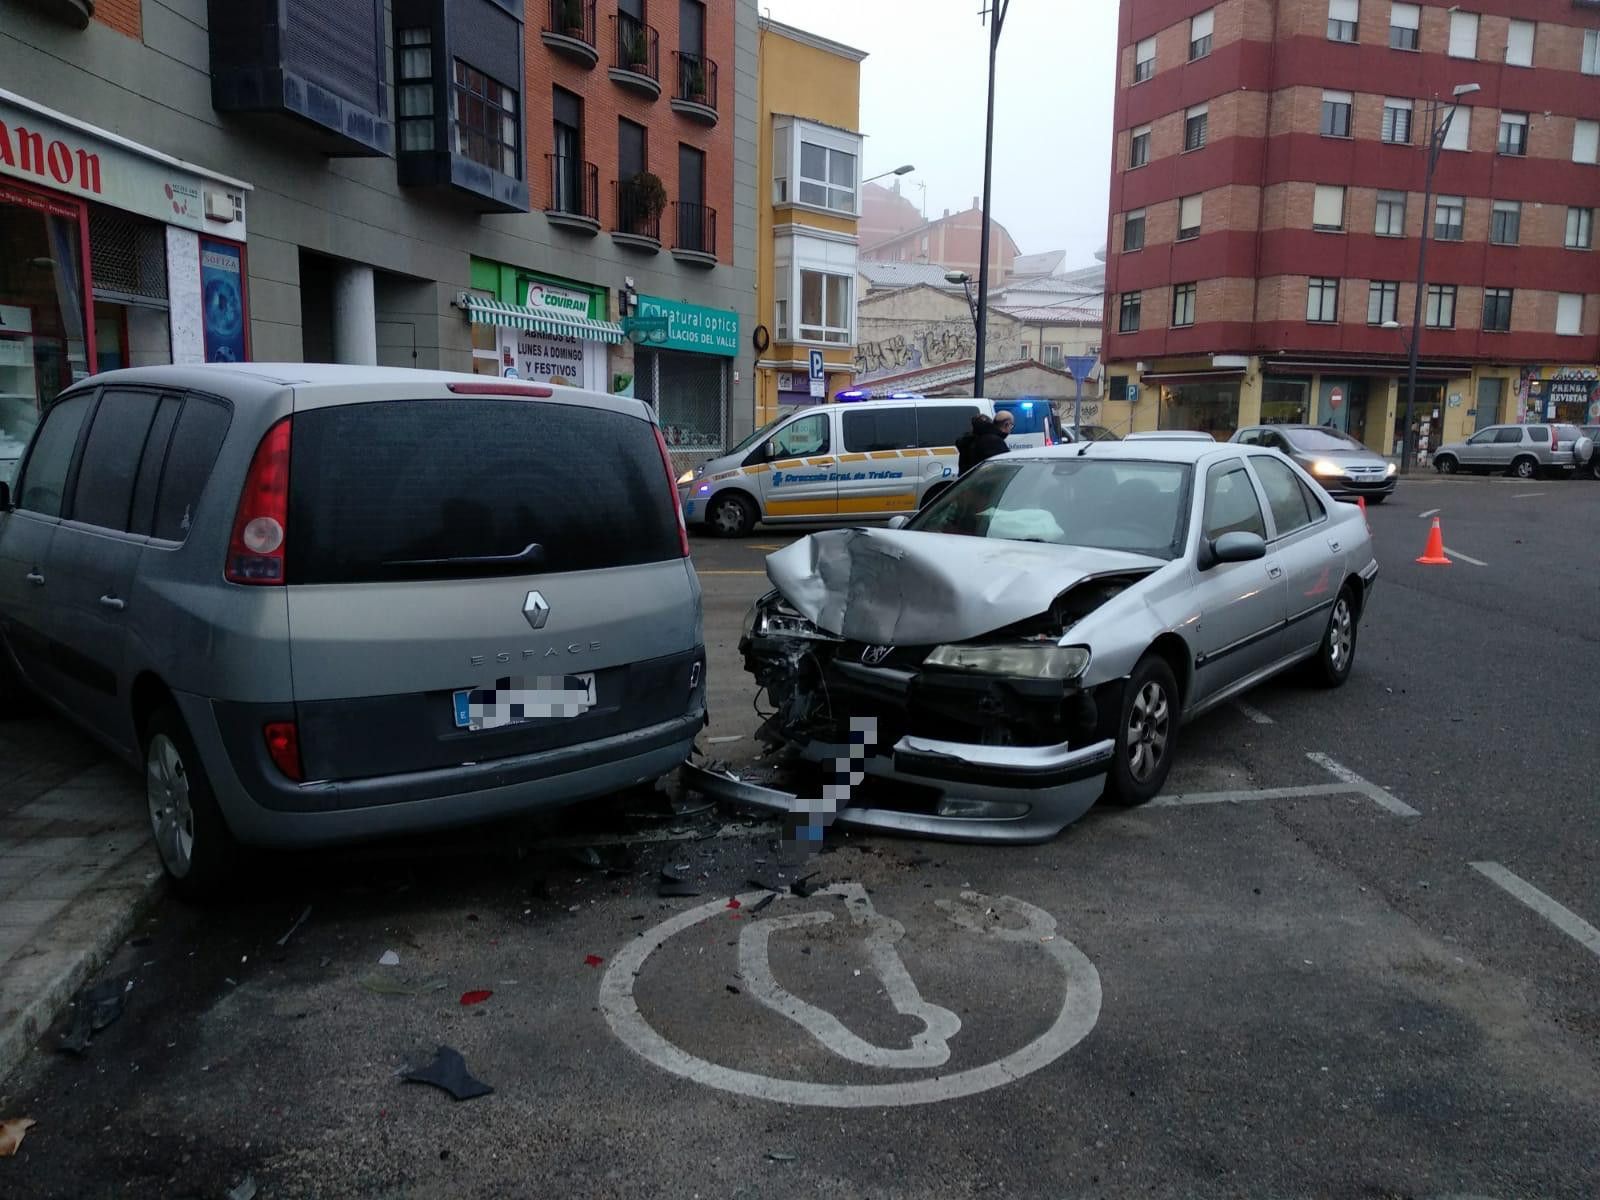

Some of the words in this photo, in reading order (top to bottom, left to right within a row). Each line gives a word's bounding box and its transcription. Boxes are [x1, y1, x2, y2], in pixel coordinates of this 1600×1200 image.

[0, 120, 101, 194] anon
[544, 294, 586, 312] COVIRAN
[661, 308, 702, 327] natural
[705, 315, 737, 333] optics
[671, 329, 699, 343] LACIOS
[700, 333, 715, 345] DEL
[716, 335, 737, 348] VALLE
[517, 342, 542, 357] LUNES
[543, 346, 550, 358] A
[550, 347, 583, 361] DOMINGO
[525, 361, 533, 373] Y
[534, 361, 577, 377] FESTIVOS
[813, 353, 822, 378] P
[1128, 386, 1136, 400] P
[1550, 393, 1588, 403] REVISTAS
[854, 472, 866, 480] de
[470, 640, 601, 666] ESPACE
